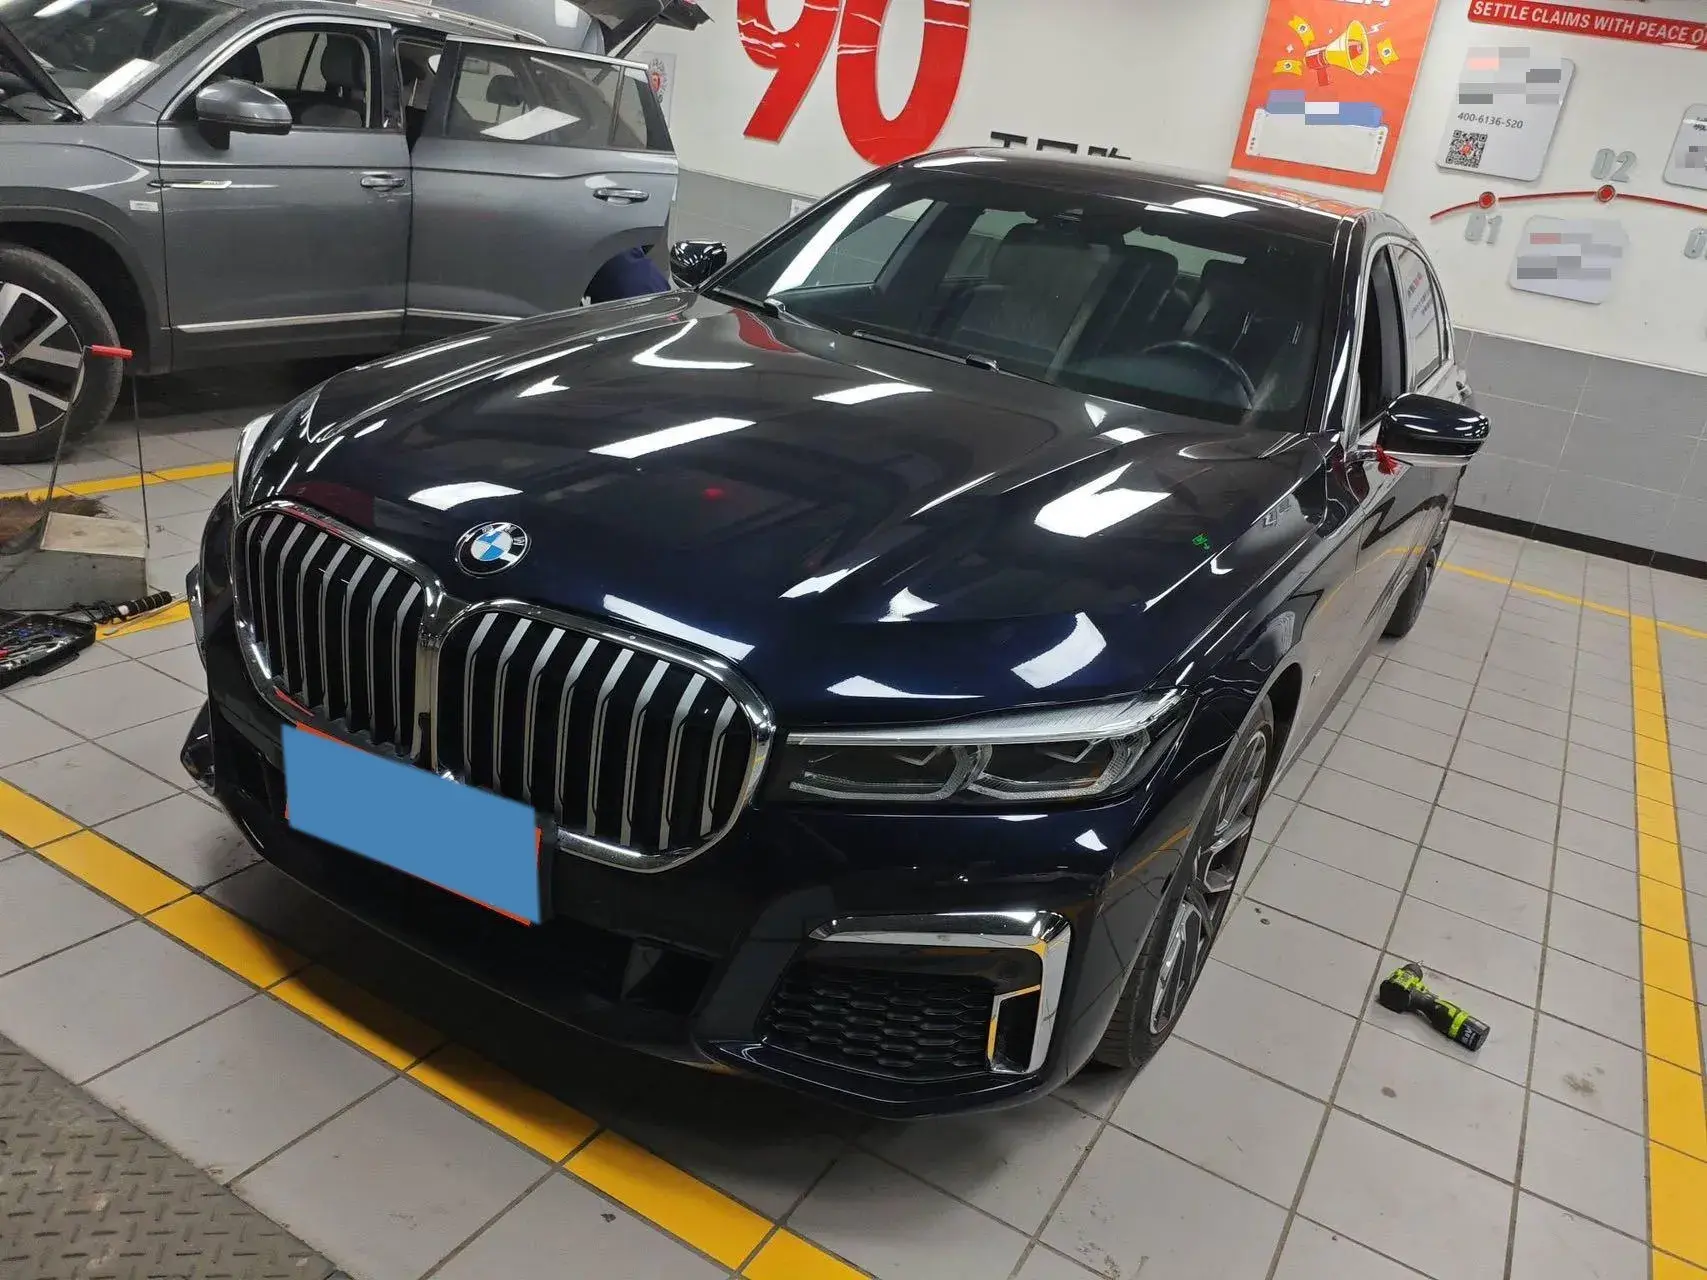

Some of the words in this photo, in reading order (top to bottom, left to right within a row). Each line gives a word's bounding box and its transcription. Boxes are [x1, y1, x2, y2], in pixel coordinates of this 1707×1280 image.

[1473, 1, 1528, 21] SETTLE
[1531, 9, 1590, 29] CLAIMS
[1593, 16, 1636, 34] WITH
[1636, 21, 1690, 42] PEACE
[737, 0, 971, 165] 90
[1457, 112, 1524, 129] 400-6136-520
[1591, 148, 1637, 183] 02
[1464, 212, 1503, 245] 01
[1684, 227, 1707, 259] 0
